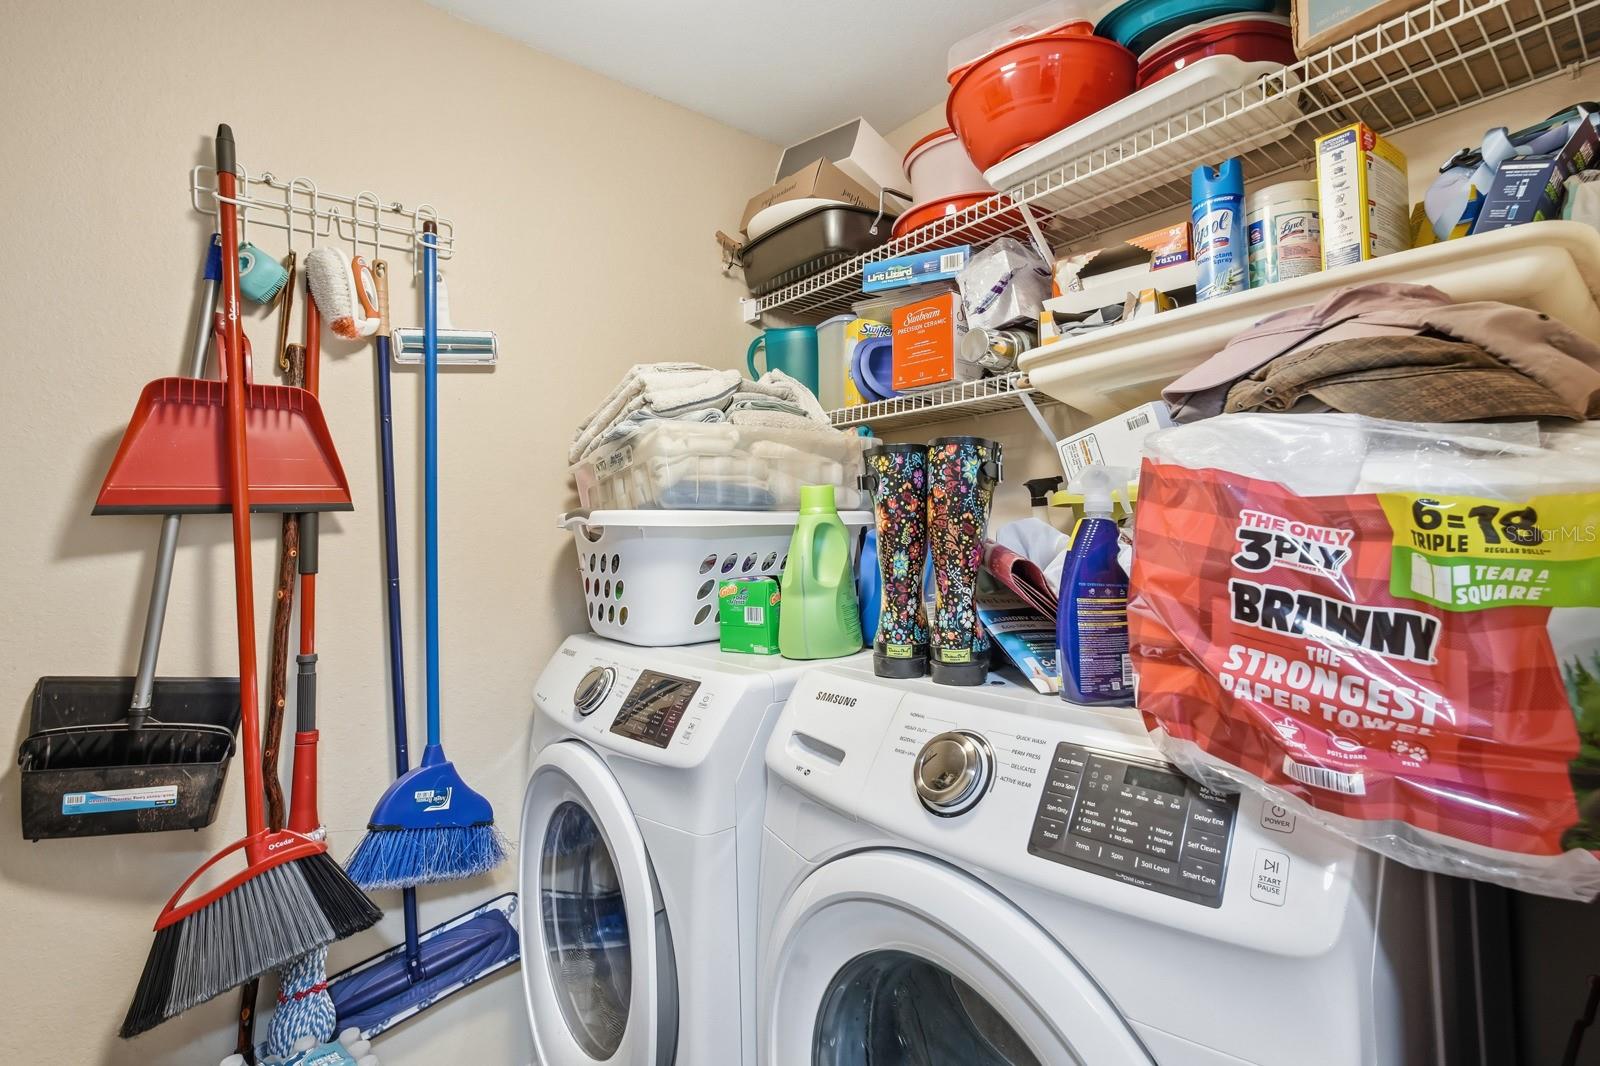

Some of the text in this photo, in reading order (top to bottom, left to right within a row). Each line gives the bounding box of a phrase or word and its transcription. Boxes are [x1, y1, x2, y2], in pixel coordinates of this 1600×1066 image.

[1155, 253, 1183, 265] ULTRA
[868, 271, 885, 283] Lint
[885, 266, 913, 279] Lizard
[903, 308, 941, 327] Sunbeam
[897, 323, 924, 335] PRECISION
[923, 317, 947, 328] CERAMIC
[1242, 512, 1350, 546] THE ONLY
[1410, 529, 1468, 553] TRIPLE
[1474, 565, 1549, 583] TEAR A
[1455, 584, 1545, 605] SQUARE
[988, 615, 1028, 624] LAUNDRY
[1231, 582, 1438, 661] BRAWNY
[1305, 646, 1341, 668] THE
[1222, 645, 1443, 726] STRONGEST
[816, 691, 858, 708] SAMSUNG
[1026, 752, 1041, 760] PRESS
[1327, 749, 1344, 759] POTS
[1058, 757, 1071, 765] Extra
[1402, 760, 1421, 768] PETS
[1010, 763, 1037, 774] DELICATES
[1000, 776, 1032, 788] ACTIVE WEAR
[1052, 780, 1065, 788] Extra
[1086, 800, 1096, 808] Hot
[1153, 798, 1164, 806] Spin
[1046, 803, 1069, 815] Spin Only
[1085, 809, 1099, 817] Warm
[1120, 808, 1133, 816] High
[1091, 820, 1106, 828] Warm
[1118, 817, 1139, 827] Medium
[1193, 814, 1224, 827] Delay End
[1264, 816, 1291, 828] POWER
[1080, 825, 1092, 833] Cold
[1116, 825, 1127, 833] Low
[1155, 827, 1174, 837] Heavy
[1043, 831, 1059, 840] Sound
[1114, 834, 1134, 845] No Spin
[1153, 836, 1174, 846] Normal
[1152, 845, 1166, 854] Light
[1187, 841, 1200, 851] Self
[1111, 852, 1124, 861] Spin
[1140, 860, 1170, 874] Soil Level
[1182, 870, 1216, 886] Smart Care
[1258, 874, 1282, 886] START
[1257, 883, 1281, 896] PAUSE
